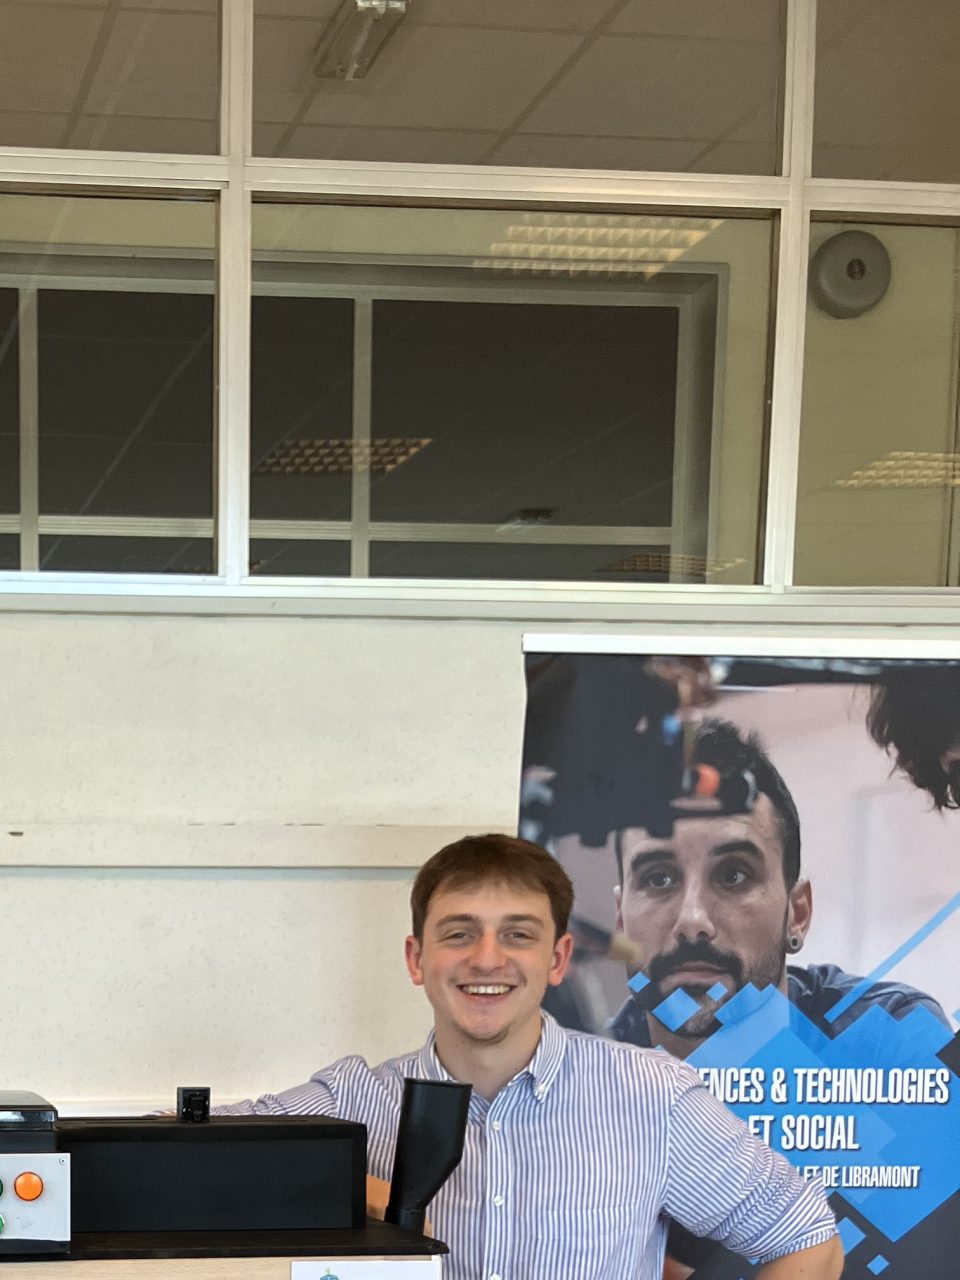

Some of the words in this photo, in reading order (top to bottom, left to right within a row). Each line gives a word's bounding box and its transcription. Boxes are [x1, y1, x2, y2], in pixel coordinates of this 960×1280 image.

[694, 1067, 765, 1103] ENCES
[771, 1067, 787, 1103] &
[793, 1068, 949, 1103] TECHNOLOGIES
[748, 1115, 775, 1148] ET
[781, 1115, 859, 1150] SOCIAL
[823, 1166, 839, 1187] DE
[842, 1166, 921, 1187] LIBRAMONT
